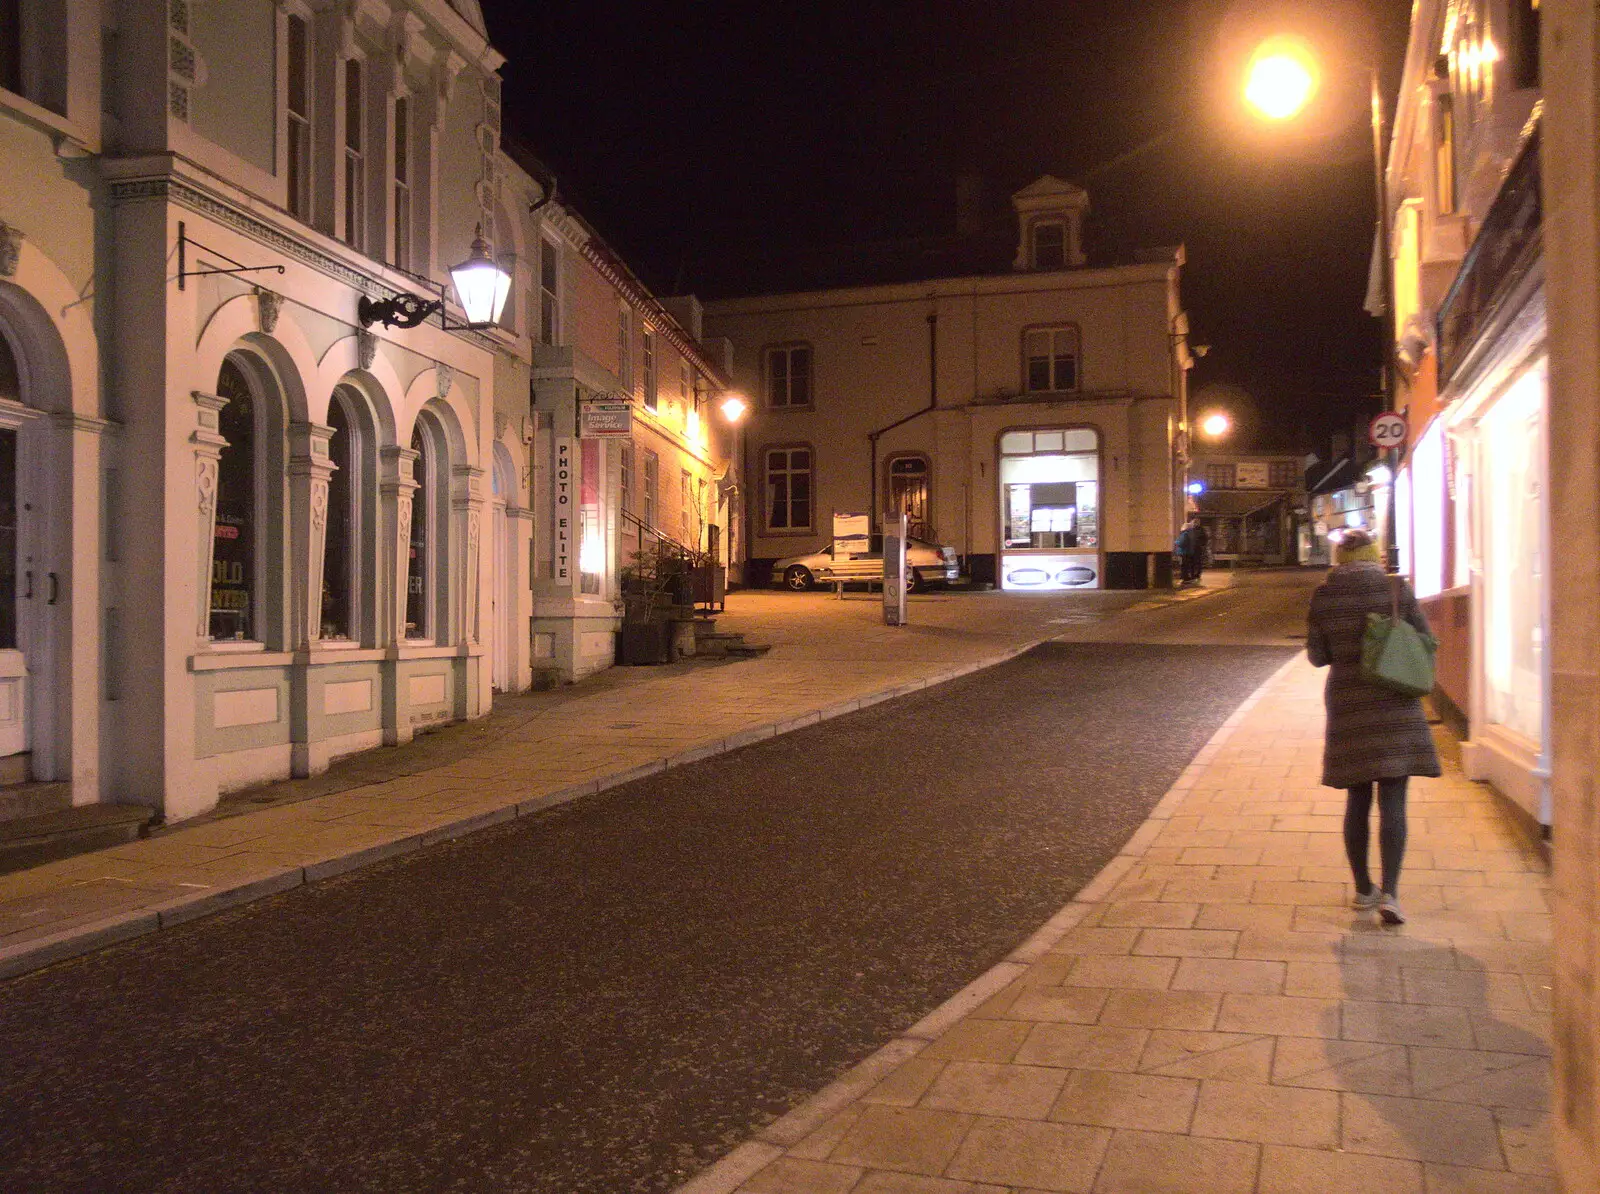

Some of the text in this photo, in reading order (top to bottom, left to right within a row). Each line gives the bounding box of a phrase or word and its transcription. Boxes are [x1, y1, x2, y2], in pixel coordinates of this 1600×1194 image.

[588, 414, 617, 423] Image
[589, 421, 623, 429] Service
[1376, 423, 1403, 438] 20
[559, 446, 567, 578] PHOTO ELITE
[213, 560, 243, 584] OLD
